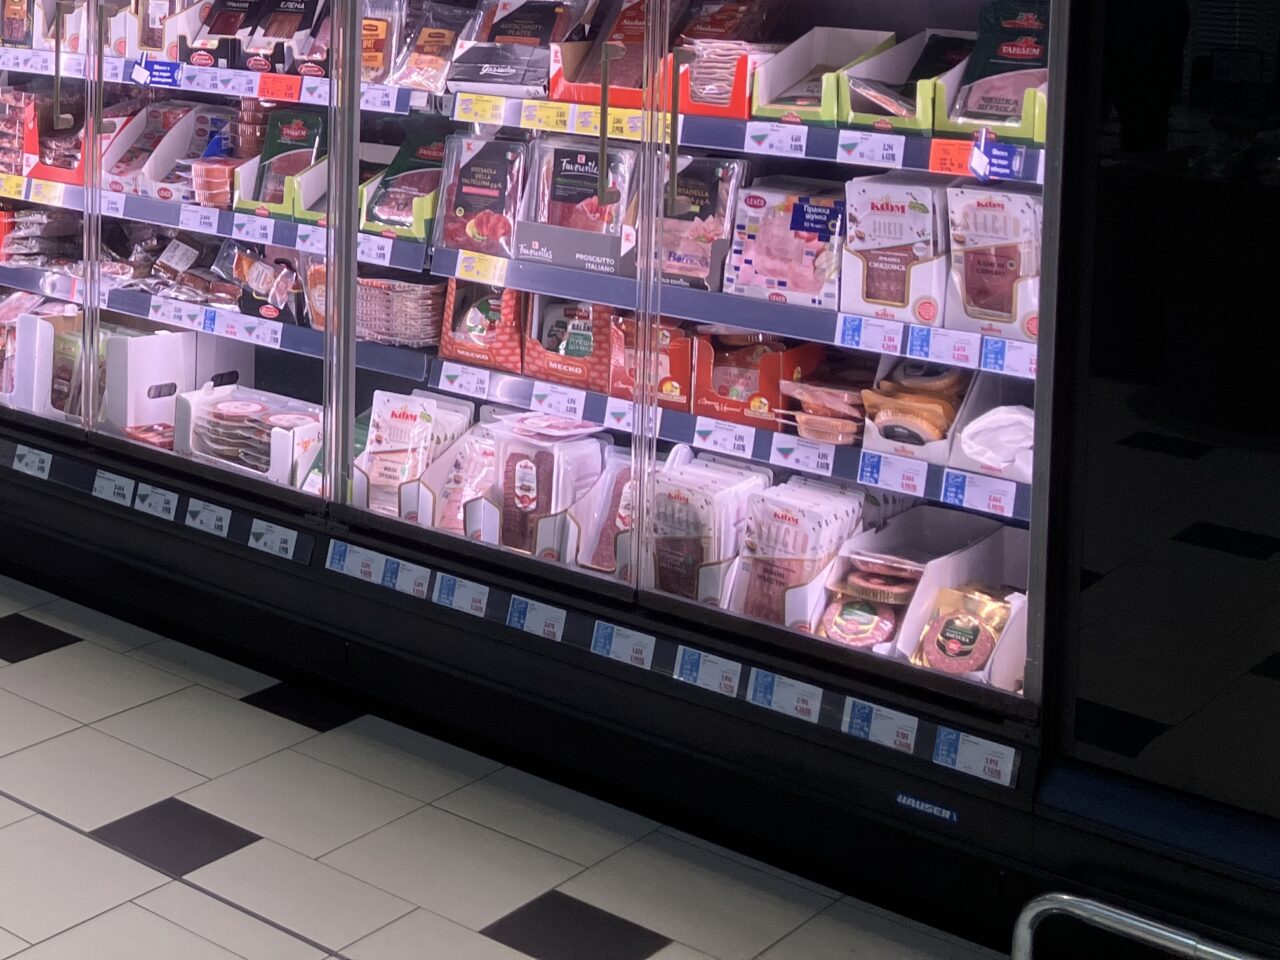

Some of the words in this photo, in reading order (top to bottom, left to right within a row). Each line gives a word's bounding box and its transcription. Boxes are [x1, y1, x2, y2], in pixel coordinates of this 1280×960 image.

[1001, 46, 1040, 56] ТАНДЕМ
[981, 96, 1019, 106] ЧЕШКА
[977, 103, 1017, 114] ШУНКА
[560, 157, 599, 174] Favourite
[803, 204, 831, 216] Пражка
[804, 213, 828, 222] шунка
[575, 253, 615, 265] PROSCIUTTO
[584, 263, 615, 273] ITALIANO
[896, 794, 951, 820] HAUSER
